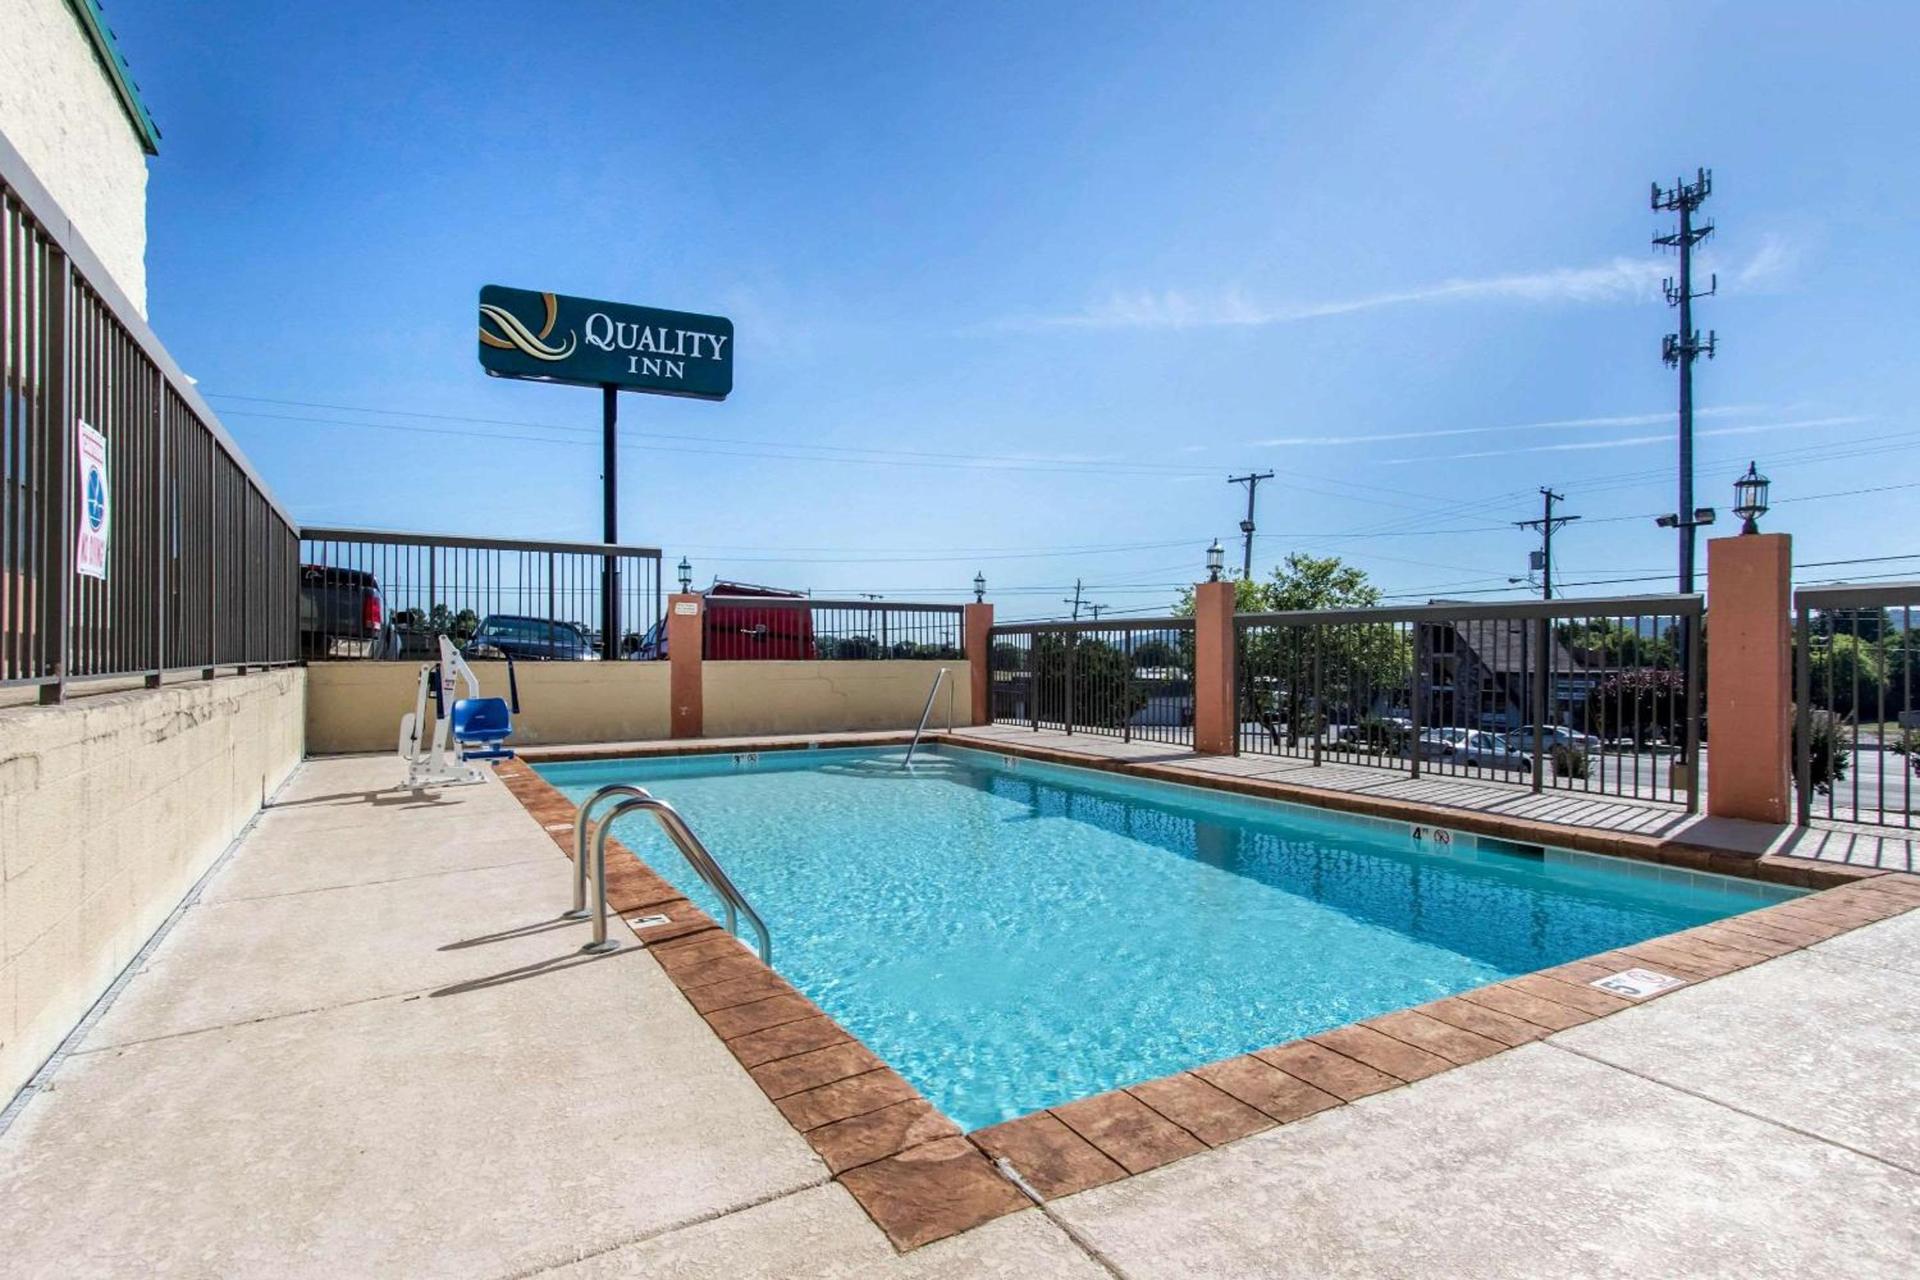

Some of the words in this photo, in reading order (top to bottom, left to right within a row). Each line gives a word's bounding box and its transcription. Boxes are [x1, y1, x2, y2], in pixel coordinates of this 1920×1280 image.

[585, 312, 728, 361] QUALITY
[628, 355, 685, 379] INN
[1413, 827, 1422, 840] 4
